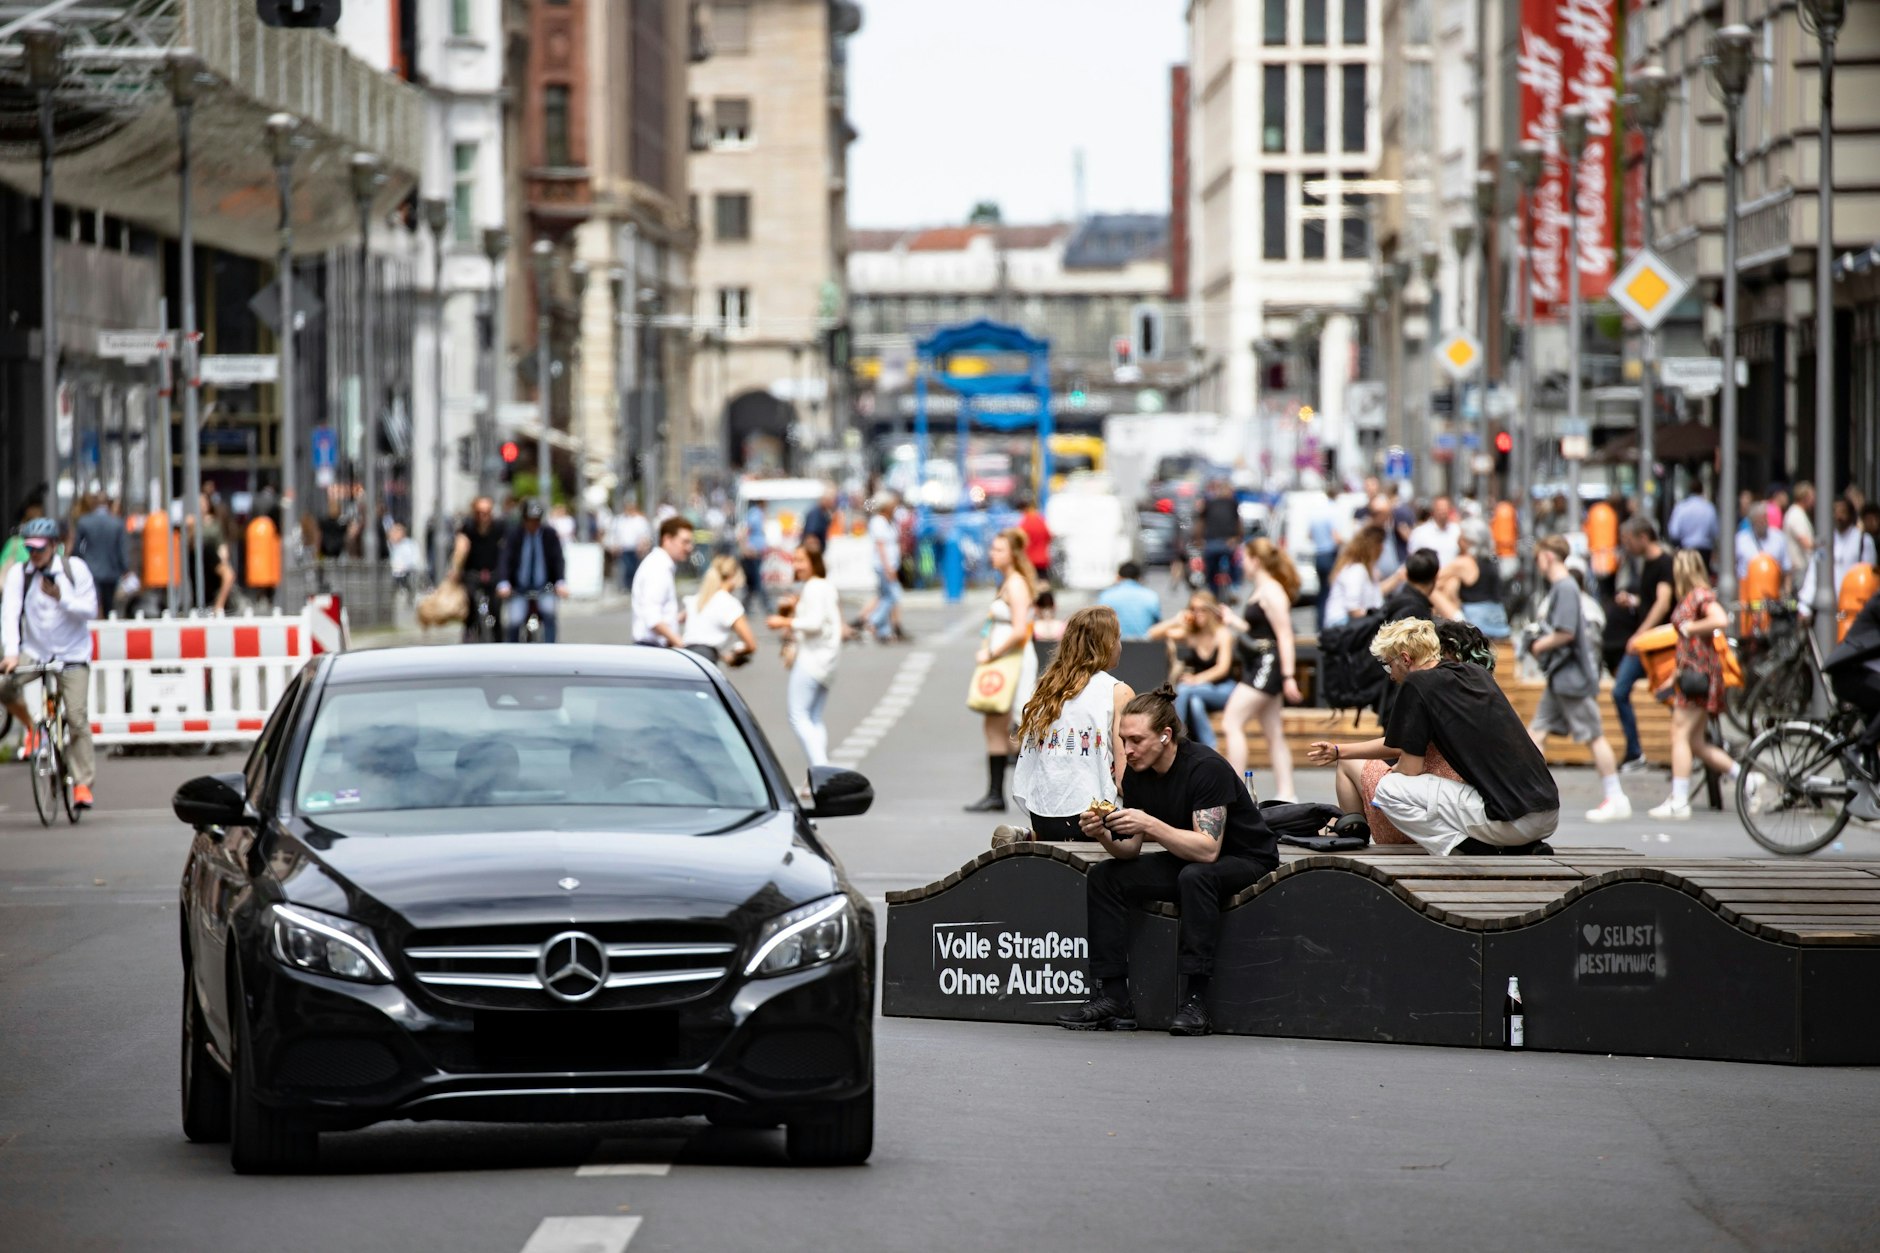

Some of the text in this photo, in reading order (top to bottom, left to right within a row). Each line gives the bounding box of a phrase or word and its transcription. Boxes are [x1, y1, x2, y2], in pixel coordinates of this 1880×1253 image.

[936, 931, 1089, 959] Volle Straßen
[1603, 925, 1654, 947] SELBST
[1579, 953, 1656, 974] BESTIMMUNG
[939, 963, 1091, 995] Ohne Autos.
